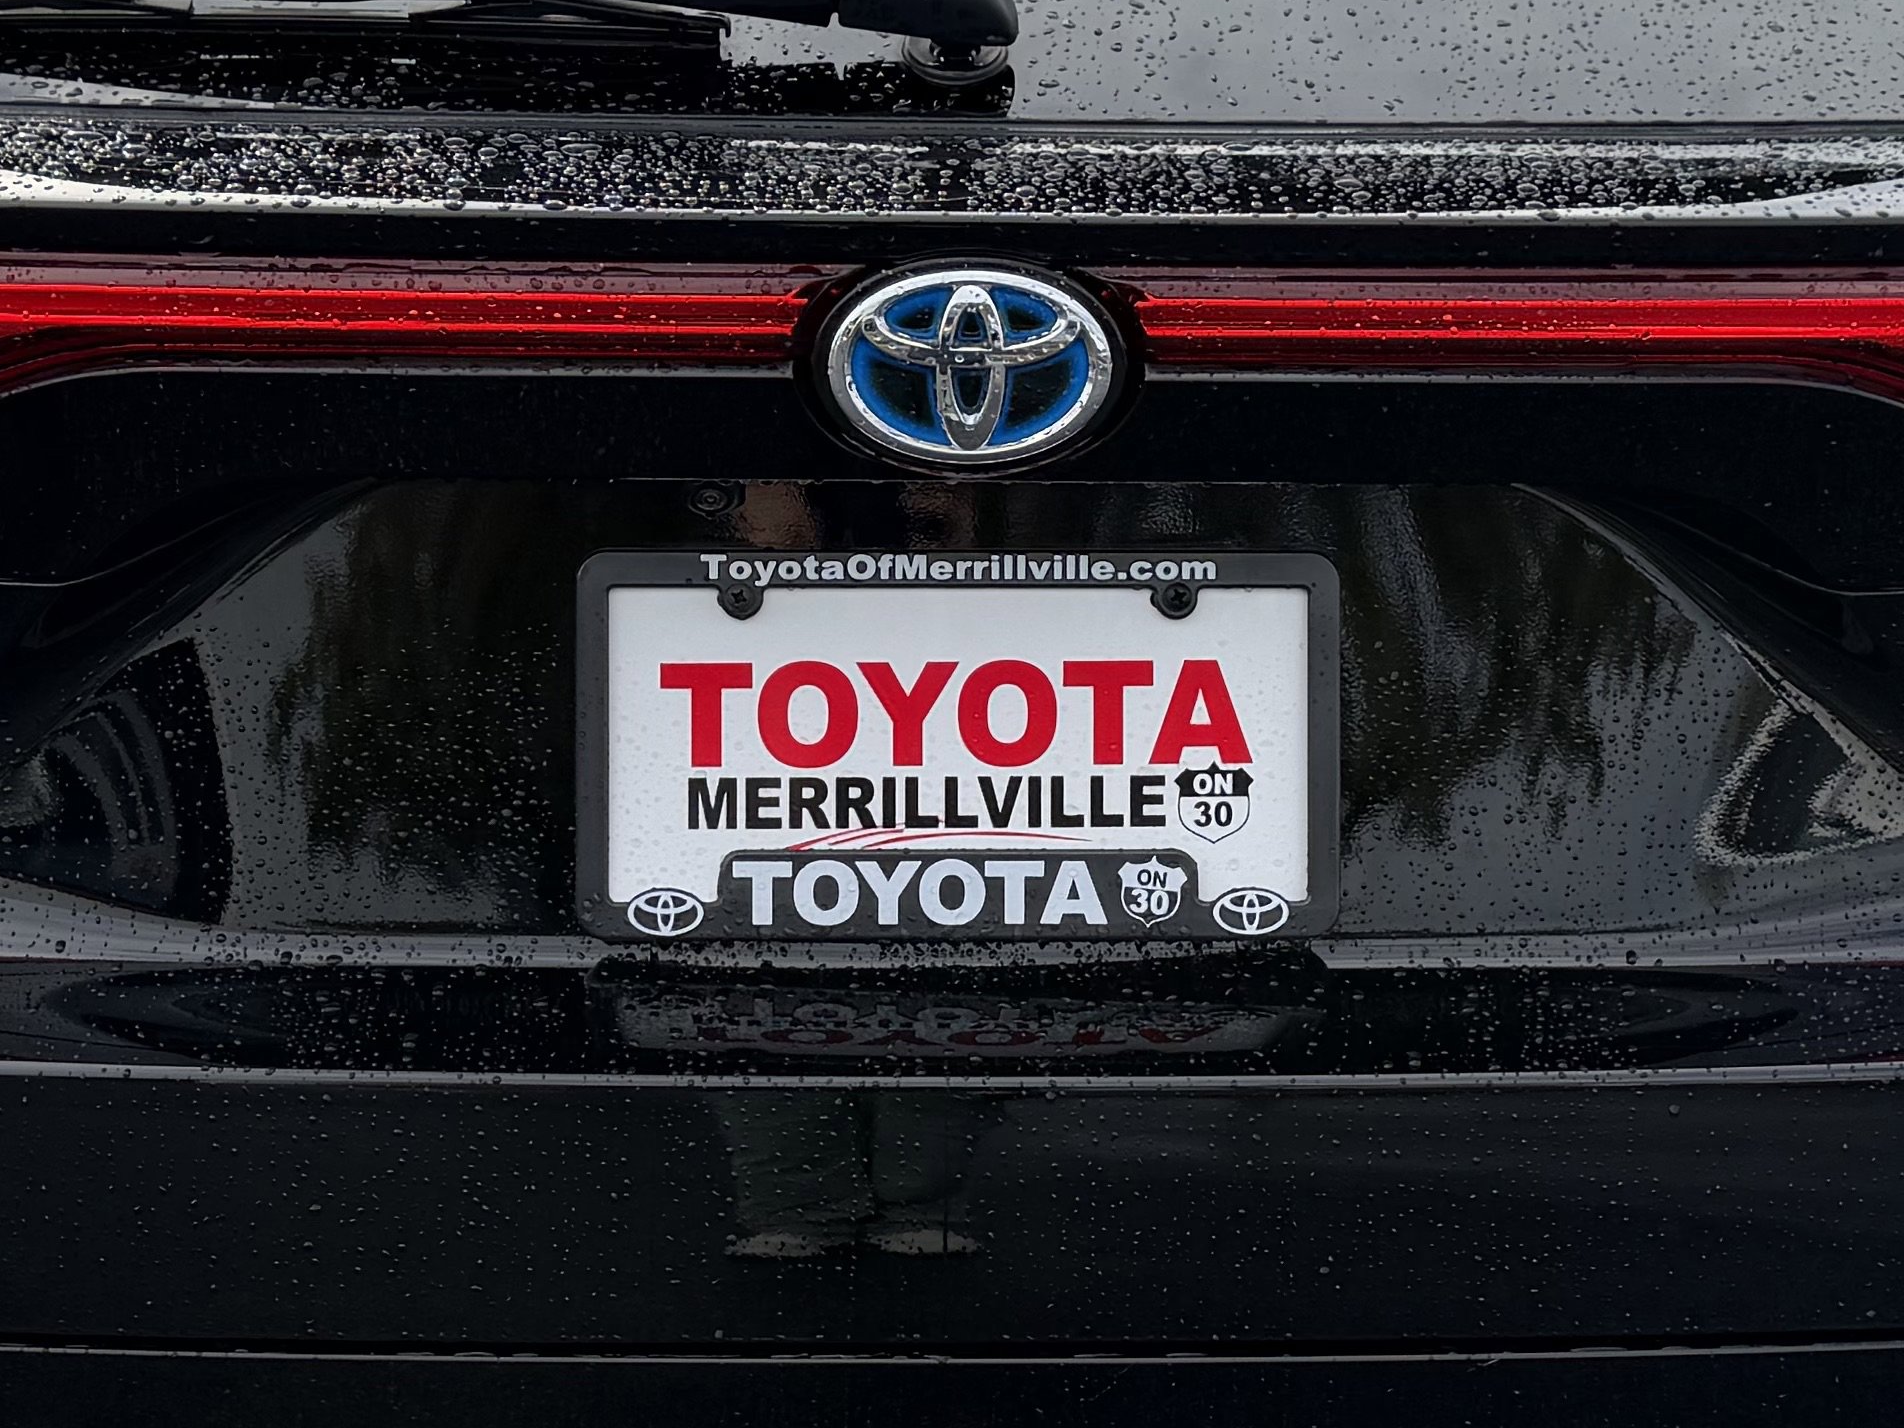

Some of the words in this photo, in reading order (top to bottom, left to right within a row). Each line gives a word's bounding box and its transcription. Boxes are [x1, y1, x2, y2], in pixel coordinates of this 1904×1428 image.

[700, 554, 1217, 586] ToyotaOfMerrillville.com
[660, 659, 1252, 767] TOYOTA
[1192, 773, 1234, 795] ON
[688, 776, 1167, 830] MERRILLVILLE
[1193, 801, 1233, 827] 30
[733, 860, 1108, 926] TOYOTA
[1136, 869, 1168, 888] ON
[1129, 888, 1170, 916] 30
